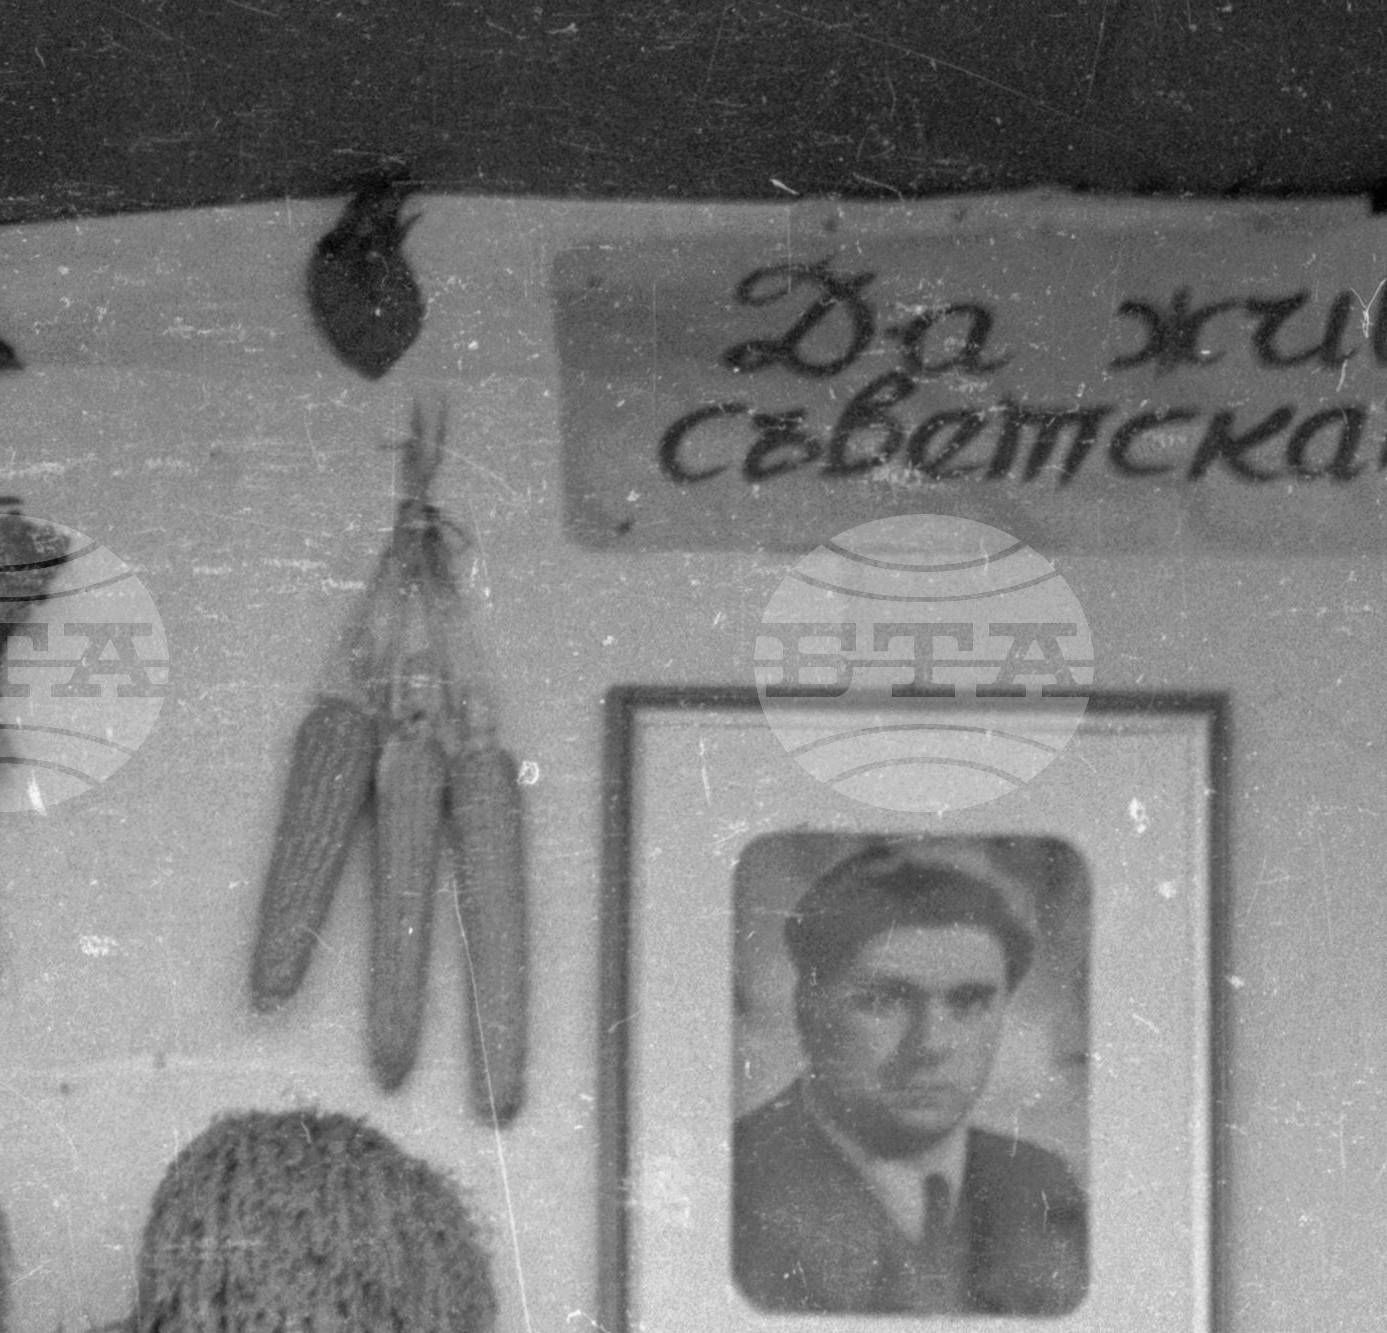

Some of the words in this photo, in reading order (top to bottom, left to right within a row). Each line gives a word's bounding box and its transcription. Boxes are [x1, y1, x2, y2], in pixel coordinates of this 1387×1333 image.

[722, 258, 1012, 378] Да
[1109, 285, 1387, 378] жи
[657, 370, 1387, 488] съветска
